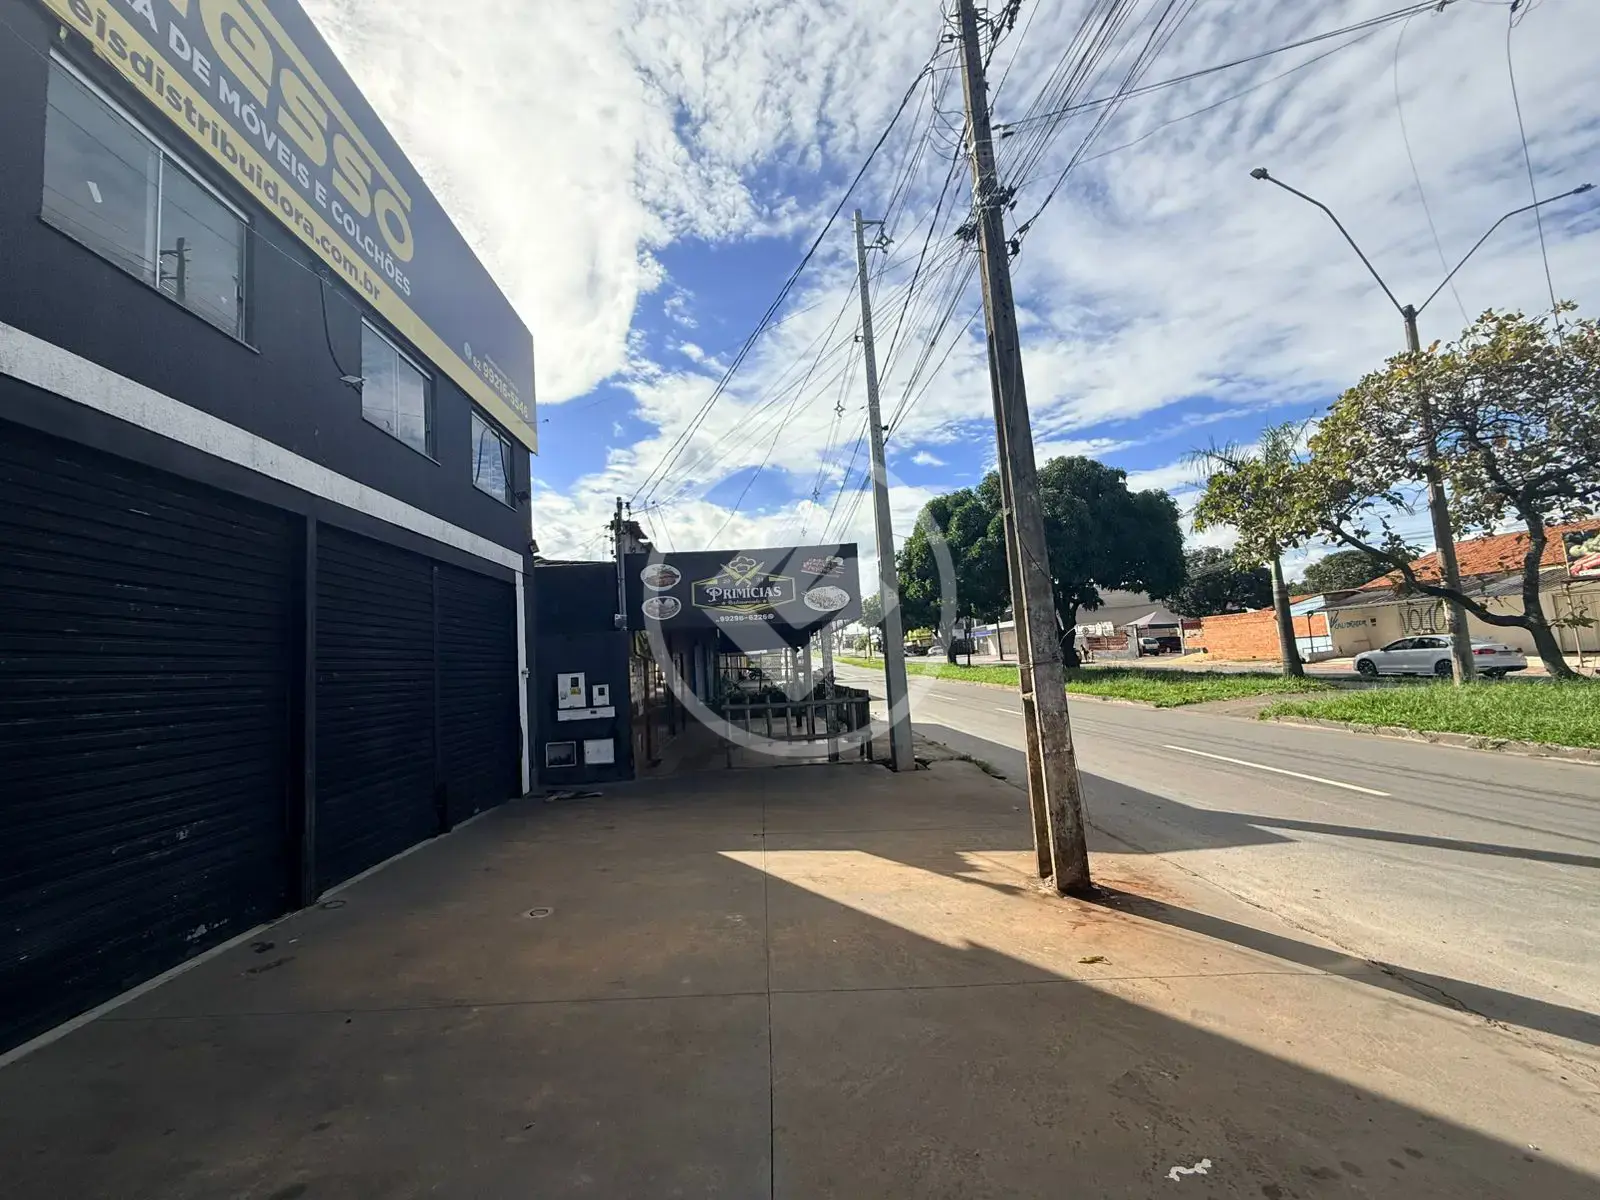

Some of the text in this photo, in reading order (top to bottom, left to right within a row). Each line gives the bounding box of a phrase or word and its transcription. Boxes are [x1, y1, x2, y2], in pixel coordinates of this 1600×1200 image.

[168, 21, 211, 88] DE
[219, 76, 309, 190] MÓVEIS
[315, 180, 327, 209] E
[331, 201, 411, 297] COLCHÕES
[706, 585, 782, 603] PRIMÍCIAS
